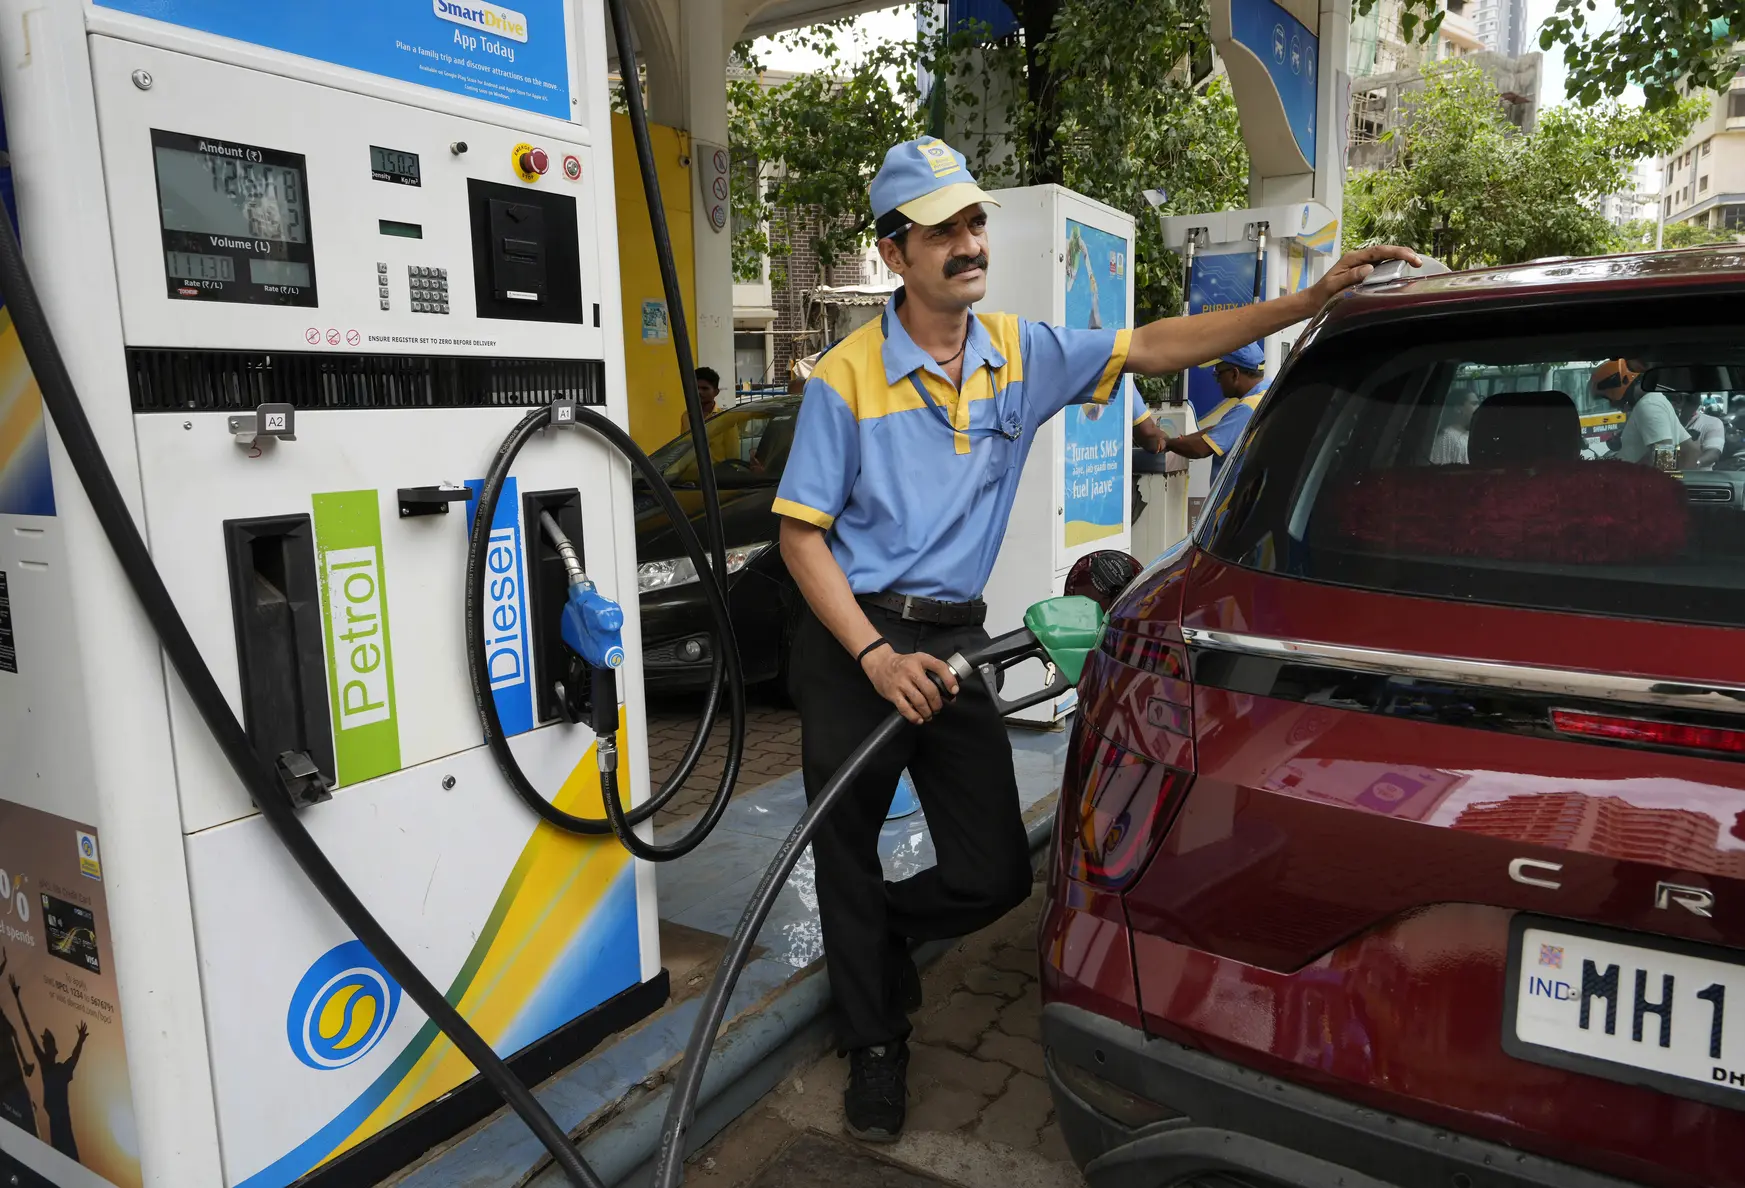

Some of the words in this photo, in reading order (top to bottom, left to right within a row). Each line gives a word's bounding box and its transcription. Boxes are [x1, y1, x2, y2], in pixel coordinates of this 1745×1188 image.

[438, 0, 524, 36] SmartDrive
[453, 29, 476, 51] App
[480, 36, 514, 62] Today
[396, 40, 411, 52] Plan
[418, 47, 439, 60] family
[440, 53, 452, 64] trip
[453, 56, 465, 66] and
[466, 59, 491, 73] discover
[492, 66, 523, 82] attractions
[524, 76, 532, 84] on
[532, 77, 542, 87] the
[444, 70, 457, 80] Google
[457, 73, 466, 82] Play
[464, 84, 478, 95] Coming
[200, 141, 243, 158] Amount
[371, 171, 391, 181] Density
[210, 236, 252, 250] Volume
[184, 279, 200, 288] Rate
[264, 285, 279, 293] Rate
[368, 335, 391, 343] ENSURE
[391, 336, 419, 344] REGISTER
[268, 416, 283, 427] A2
[560, 409, 570, 419] A1
[1100, 440, 1118, 458] SMS
[1073, 479, 1089, 499] fuel
[486, 535, 521, 684] Diesel
[332, 559, 384, 717] Petrol
[782, 823, 805, 853] OPW
[6, 925, 36, 947] spends
[84, 953, 99, 967] VISA
[1529, 976, 1572, 1001] IND
